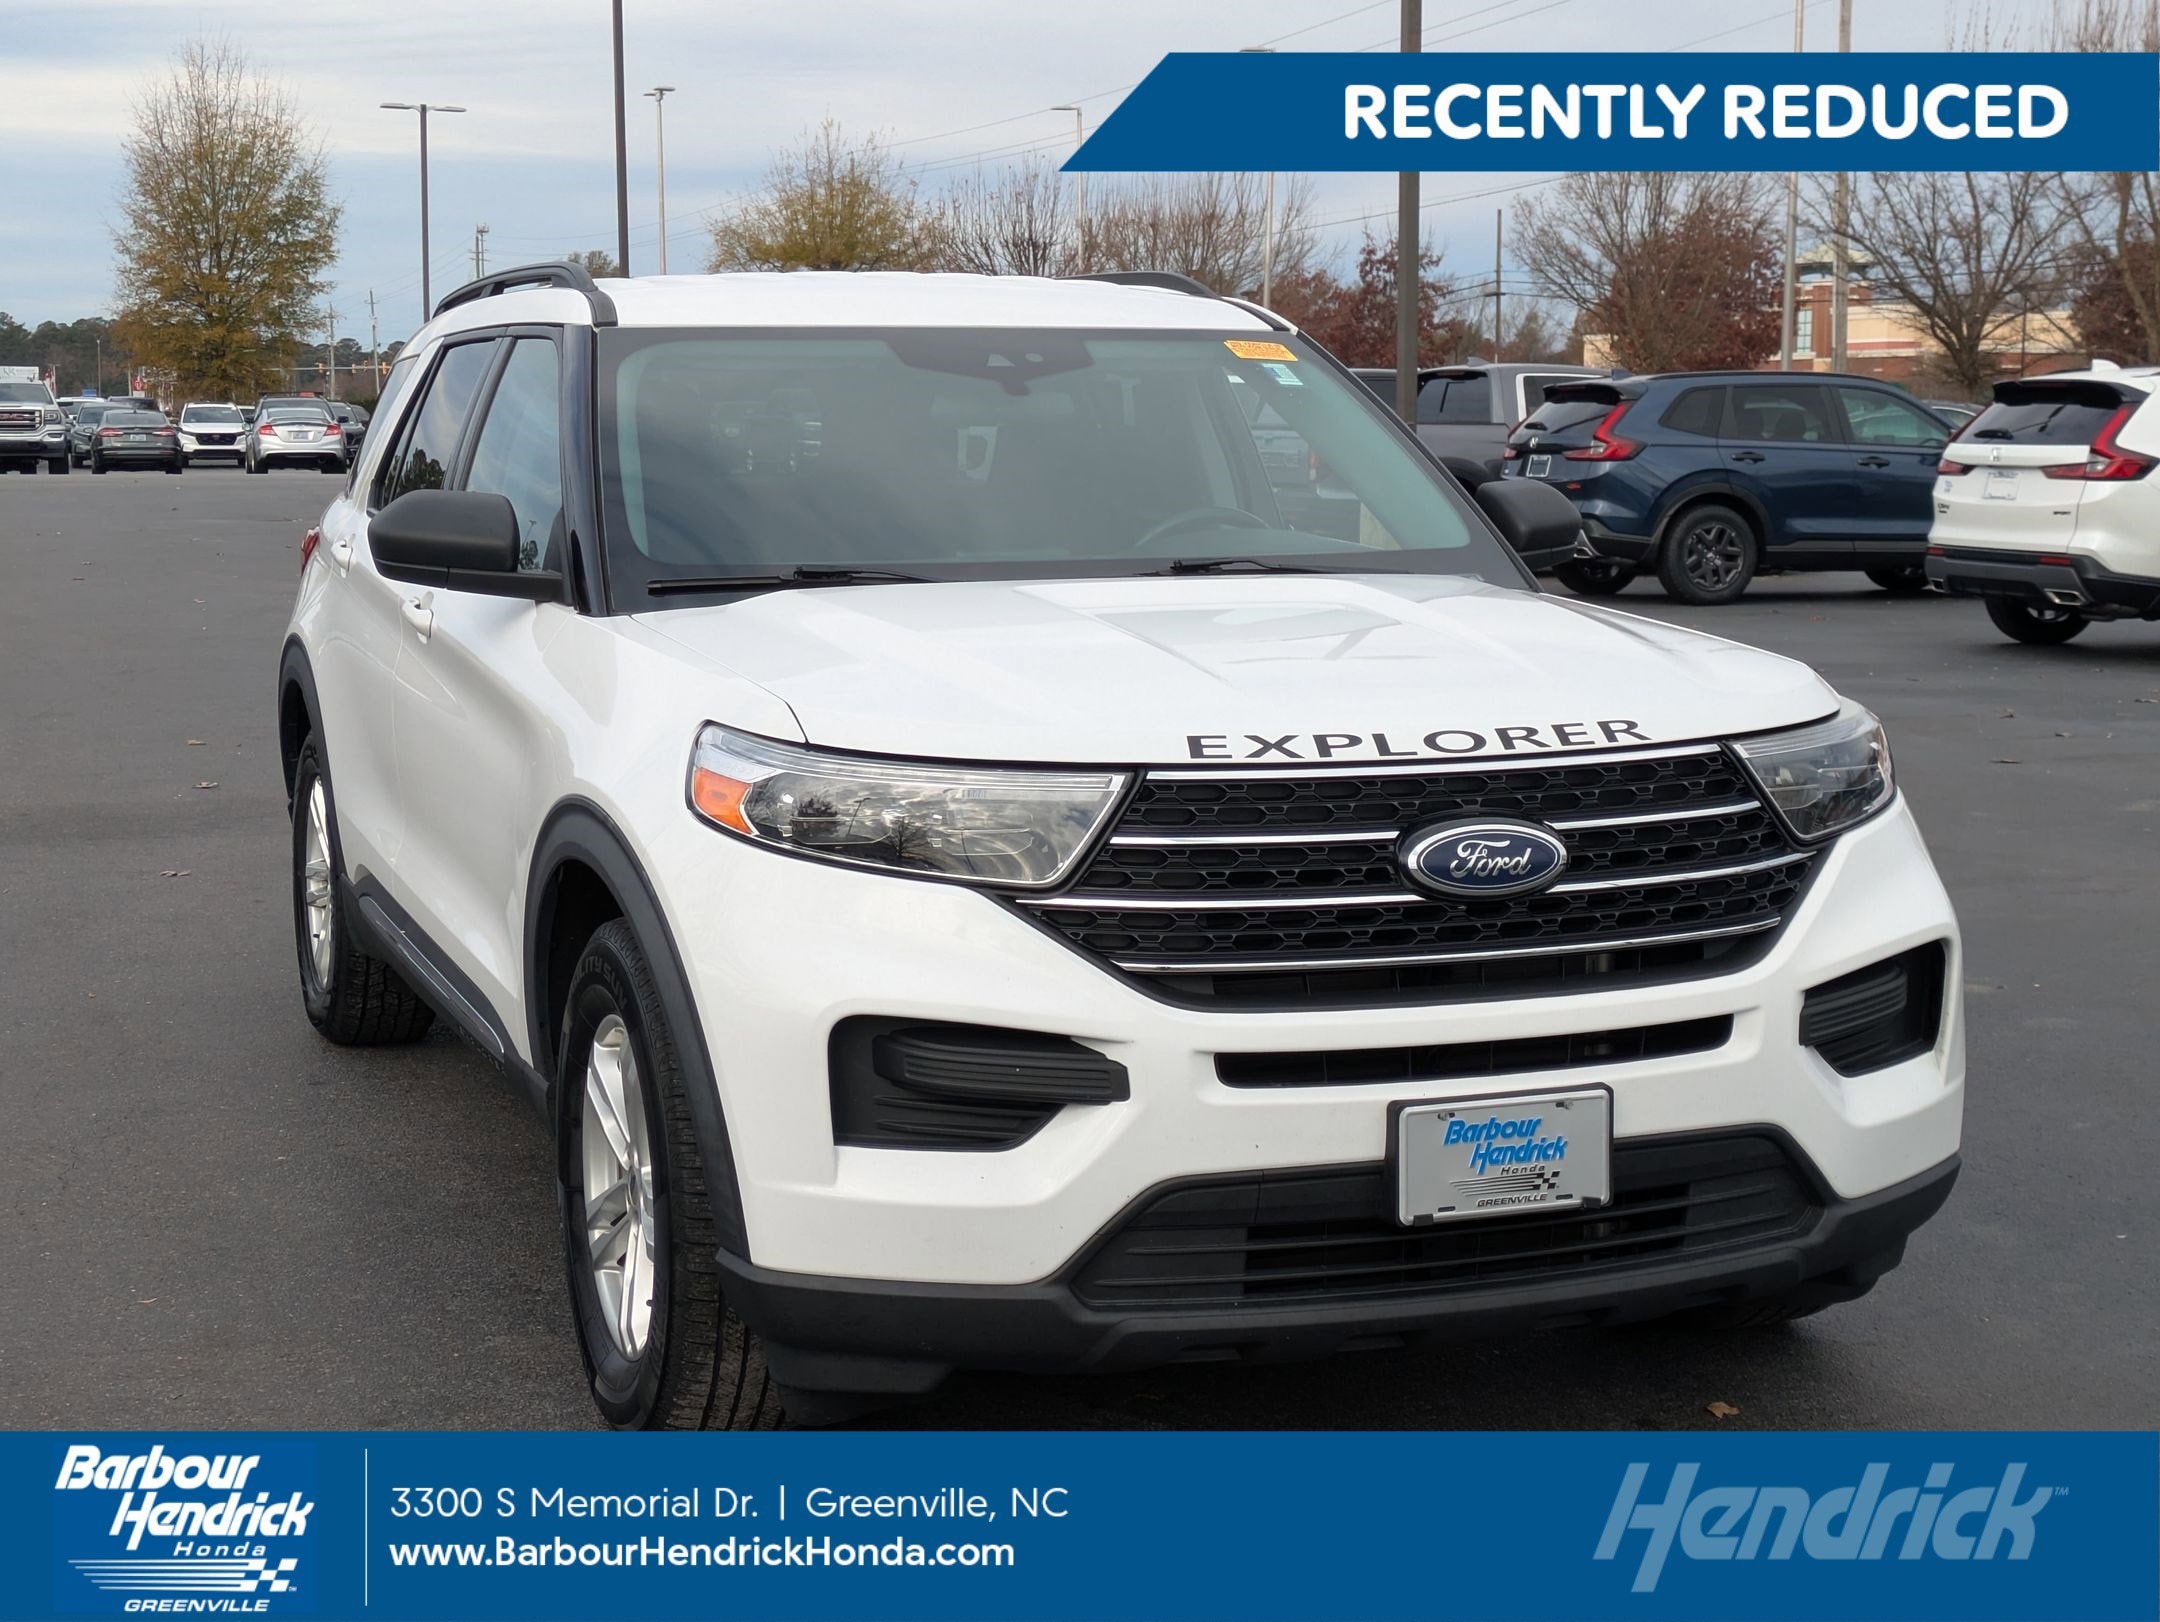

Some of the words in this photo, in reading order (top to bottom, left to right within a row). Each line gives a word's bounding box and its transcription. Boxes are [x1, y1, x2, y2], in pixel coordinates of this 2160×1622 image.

[1186, 719, 1653, 760] EXPLORER
[1449, 839, 1532, 879] Ford
[1443, 1116, 1542, 1147] Barbour
[1469, 1135, 1568, 1175] Hendrick
[1500, 1163, 1546, 1176] Honda
[1477, 1193, 1549, 1208] GREENVILLE
